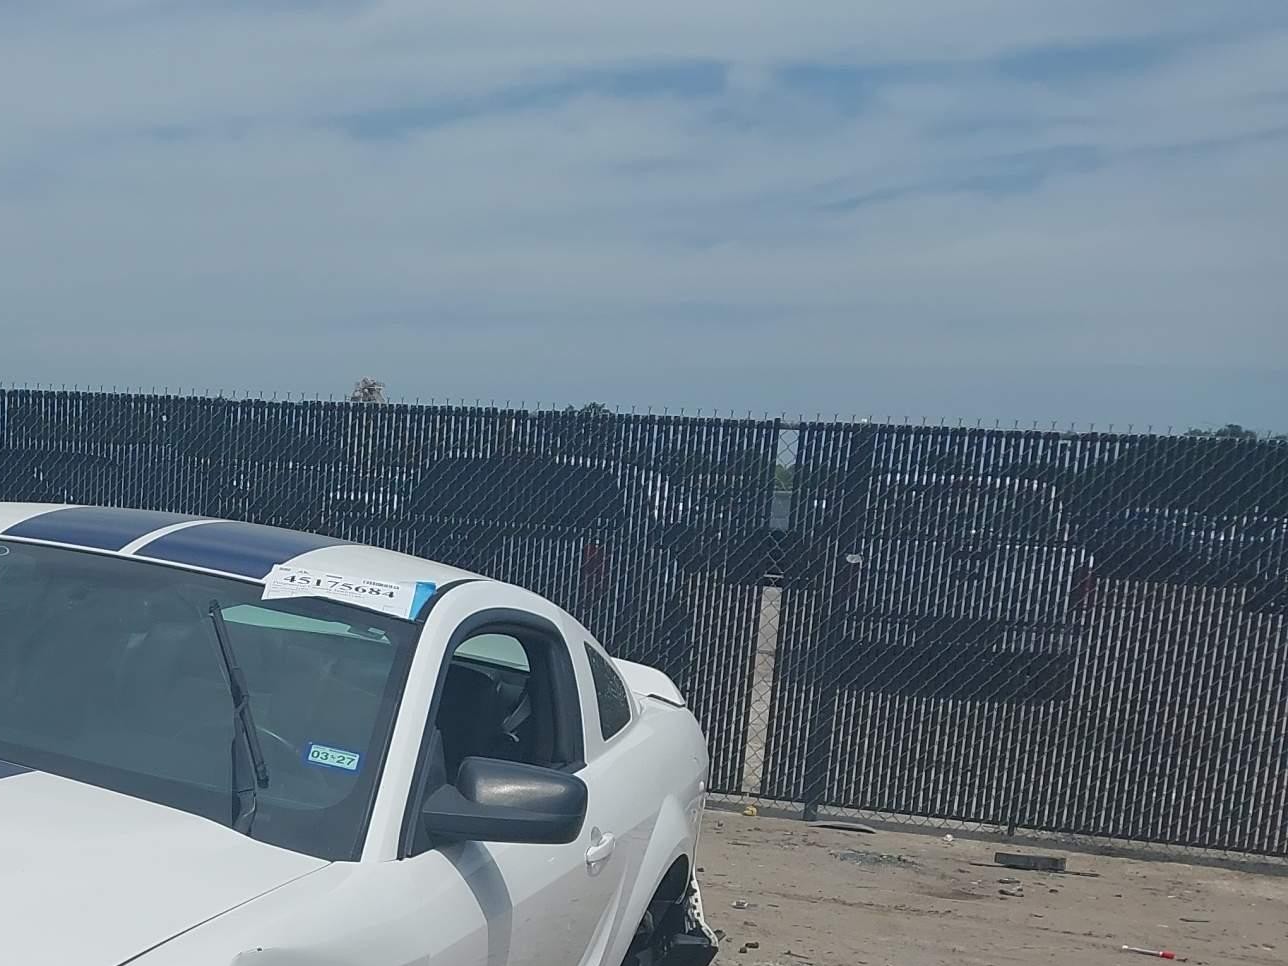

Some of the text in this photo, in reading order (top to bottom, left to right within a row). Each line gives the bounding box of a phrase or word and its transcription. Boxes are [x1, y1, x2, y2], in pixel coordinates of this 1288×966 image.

[283, 575, 394, 599] 45175684
[311, 750, 329, 761] 03
[336, 755, 356, 766] 27
